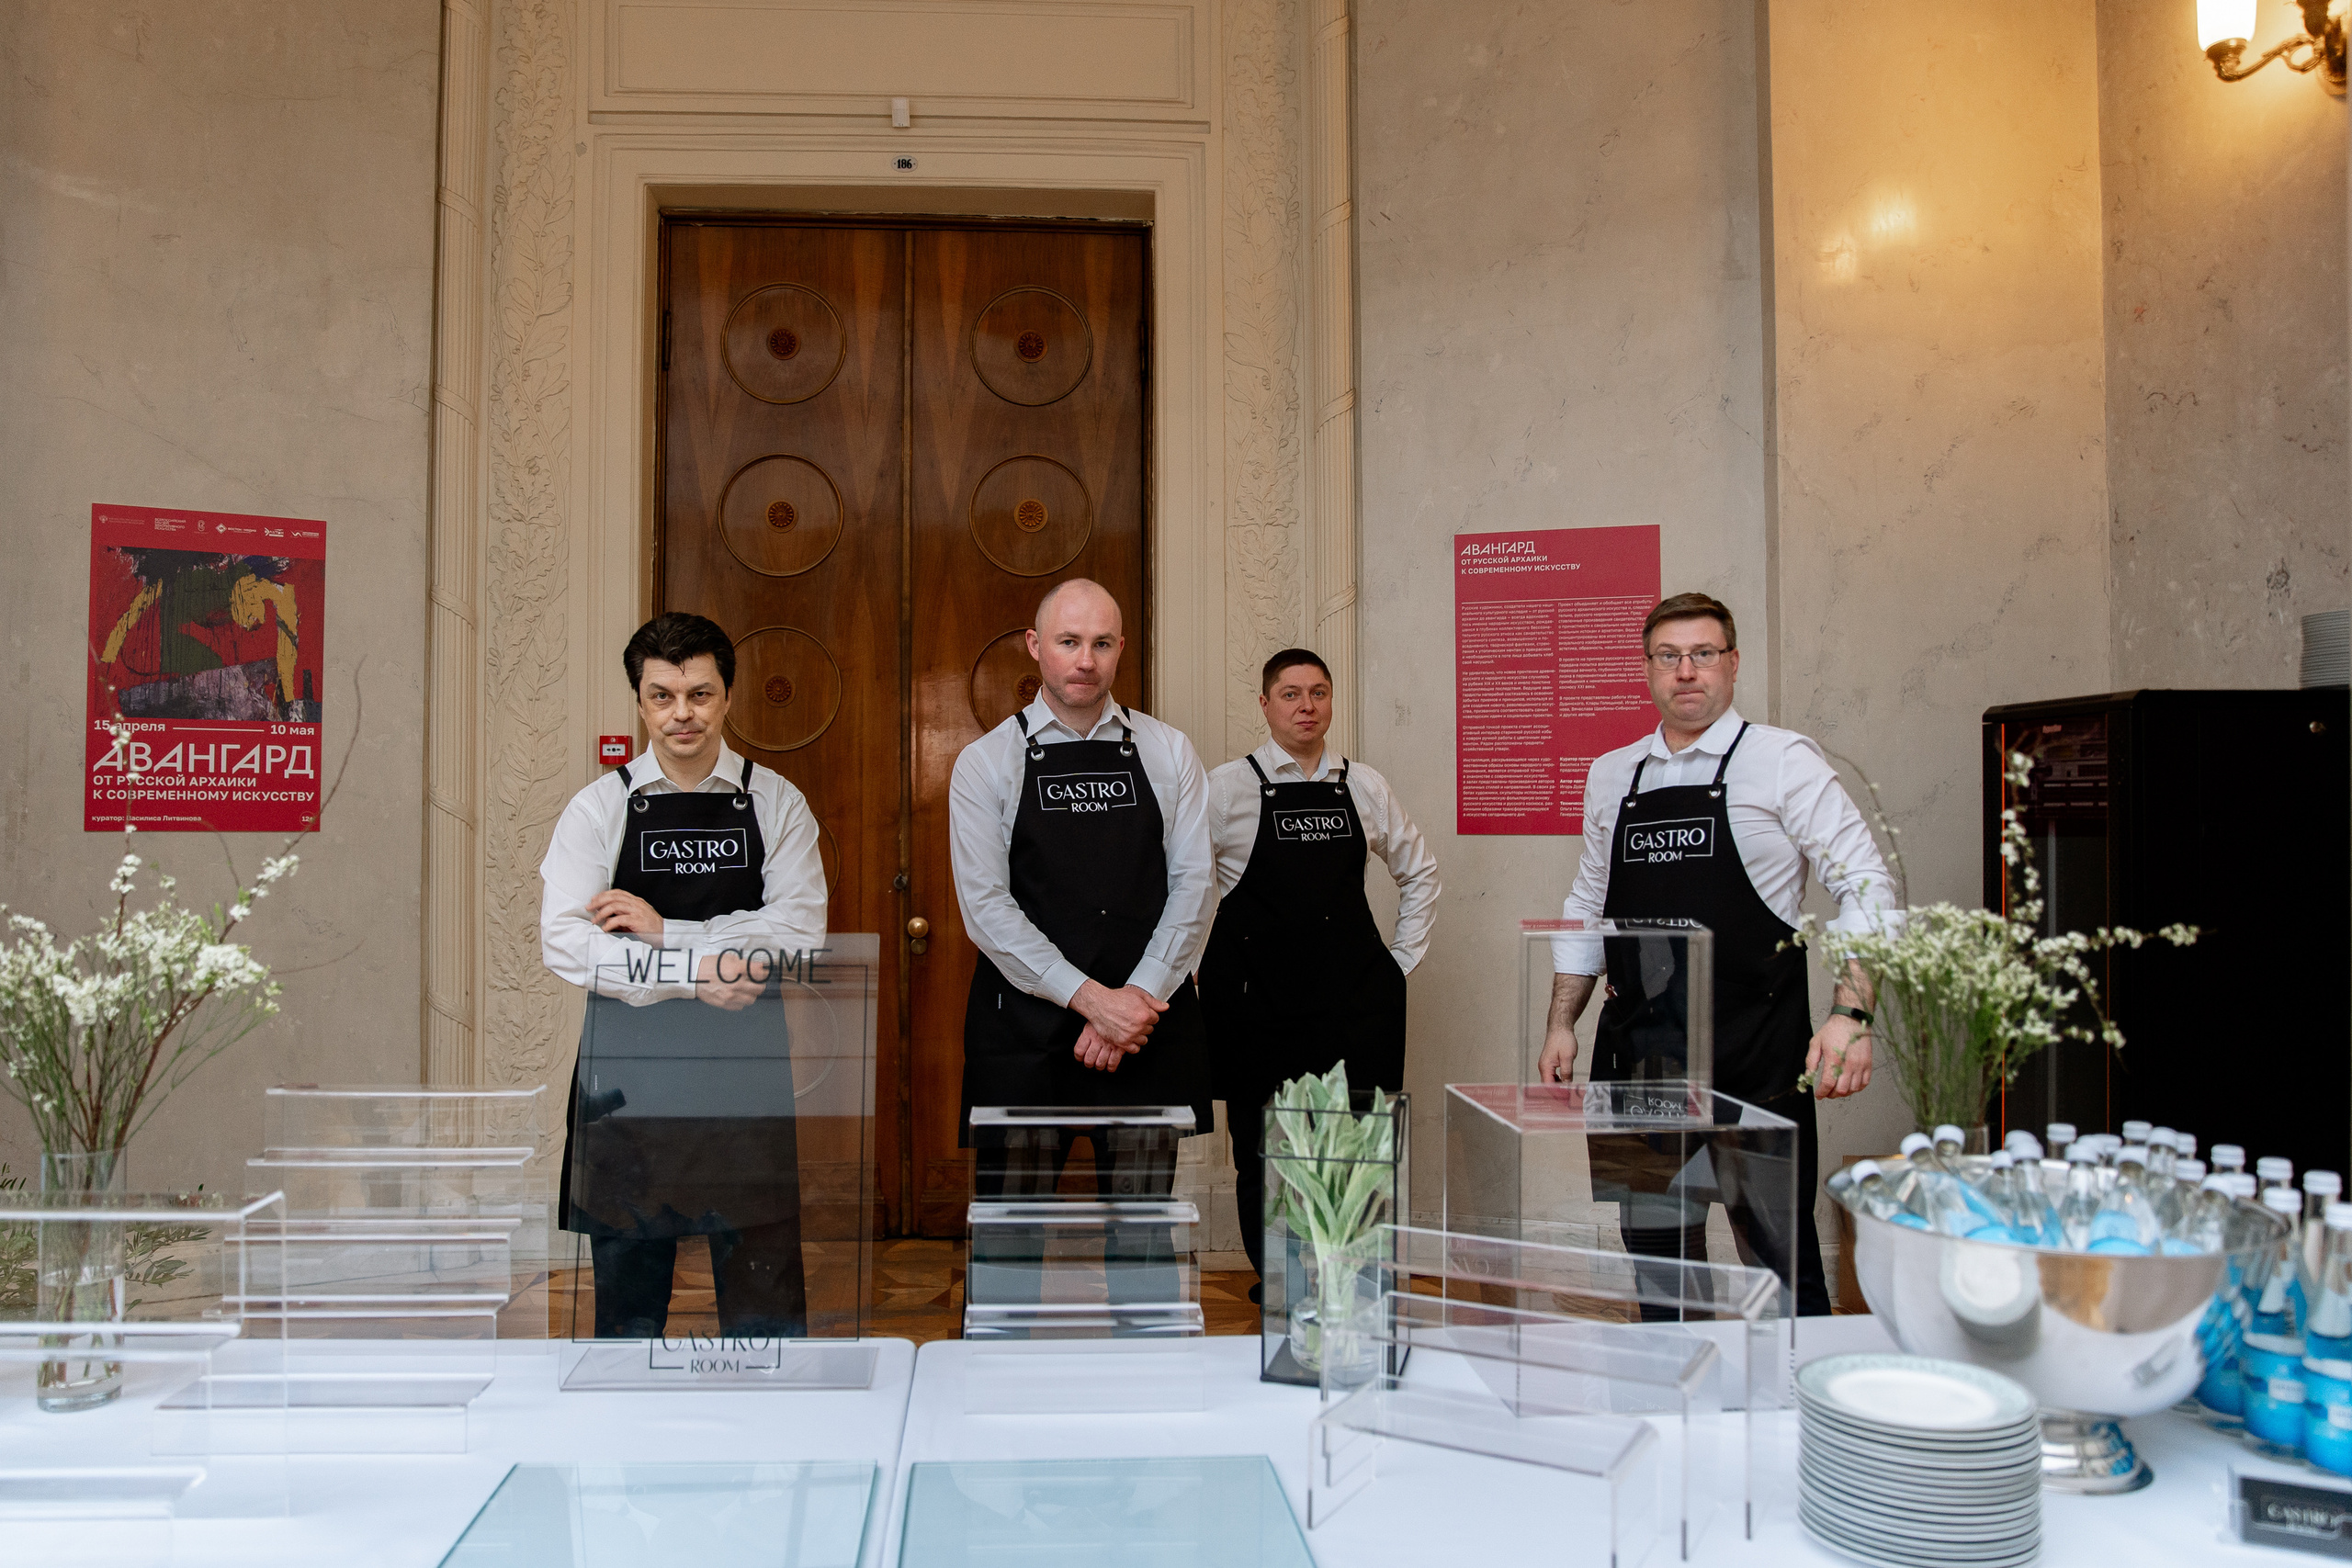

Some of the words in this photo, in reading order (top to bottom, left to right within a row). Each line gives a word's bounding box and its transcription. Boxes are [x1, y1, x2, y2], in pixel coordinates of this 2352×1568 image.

[897, 159, 912, 169] 186
[1461, 541, 1535, 556] АВАНГАРД
[1473, 556, 1510, 565] РУССКОЙ
[1510, 555, 1548, 563] АРХАИКИ
[1467, 564, 1532, 575] СОВРЕМЕННОМУ
[1533, 563, 1581, 571] ИСКУССТВУ
[94, 720, 110, 730] 15
[115, 722, 165, 733] апреля
[270, 725, 286, 735] 10
[289, 727, 315, 736] мая
[93, 741, 314, 779] АВАНГАРД
[93, 775, 111, 785] ОТ
[117, 774, 186, 786] РУССКОЙ
[189, 776, 256, 787] АРХАИКИ
[93, 790, 103, 800] К
[106, 790, 229, 801] СОВРЕМЕННОМУ
[232, 791, 314, 802] ИСКУССТВУ
[1046, 781, 1127, 800] GASTRO
[1071, 801, 1108, 813] ROOM
[1281, 816, 1344, 832] GASTRO
[1301, 832, 1330, 842] ROOM
[1630, 828, 1706, 851] GASTRO
[649, 839, 739, 860] GASTRO
[1647, 851, 1682, 863] ROOM
[674, 862, 716, 874] ROOM
[625, 948, 832, 985] WELCOME
[691, 1359, 740, 1373] ROOM
